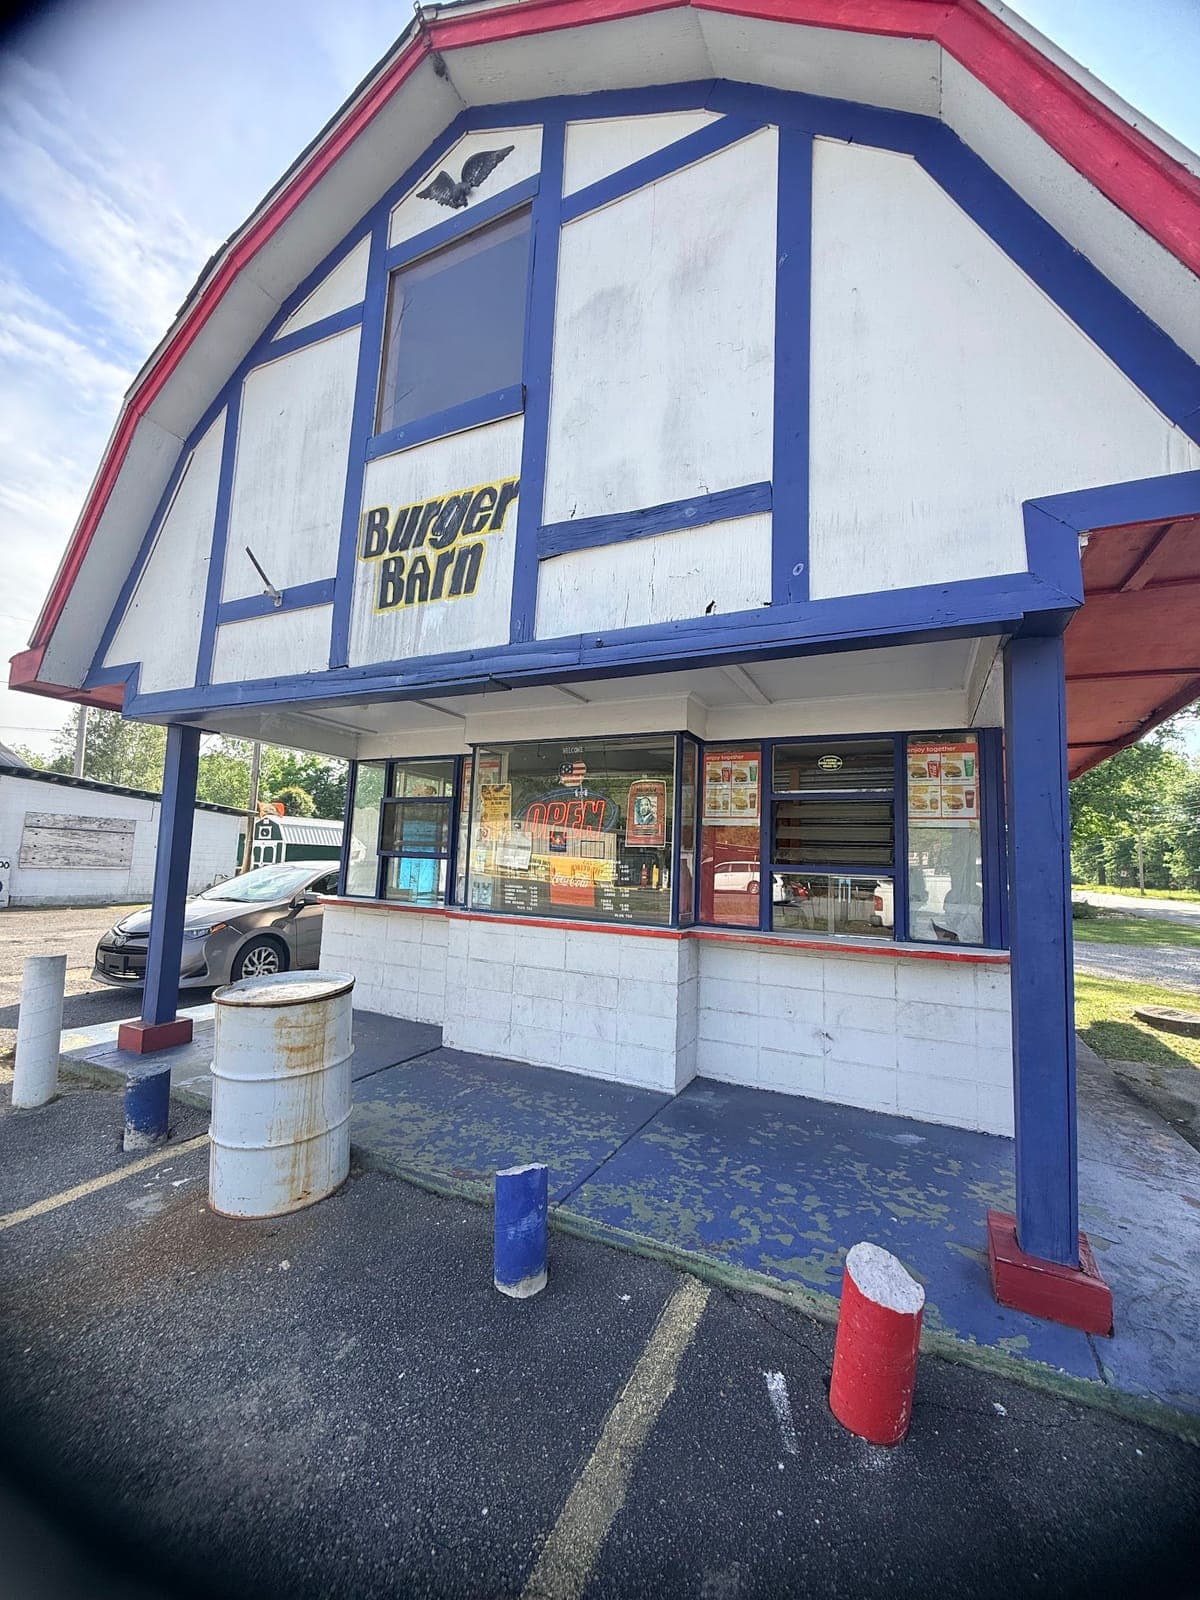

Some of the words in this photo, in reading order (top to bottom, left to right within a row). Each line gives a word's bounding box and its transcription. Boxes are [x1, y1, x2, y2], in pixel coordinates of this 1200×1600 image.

[360, 477, 520, 560] Burger
[926, 745, 956, 753] together
[524, 800, 607, 842] OPEN
